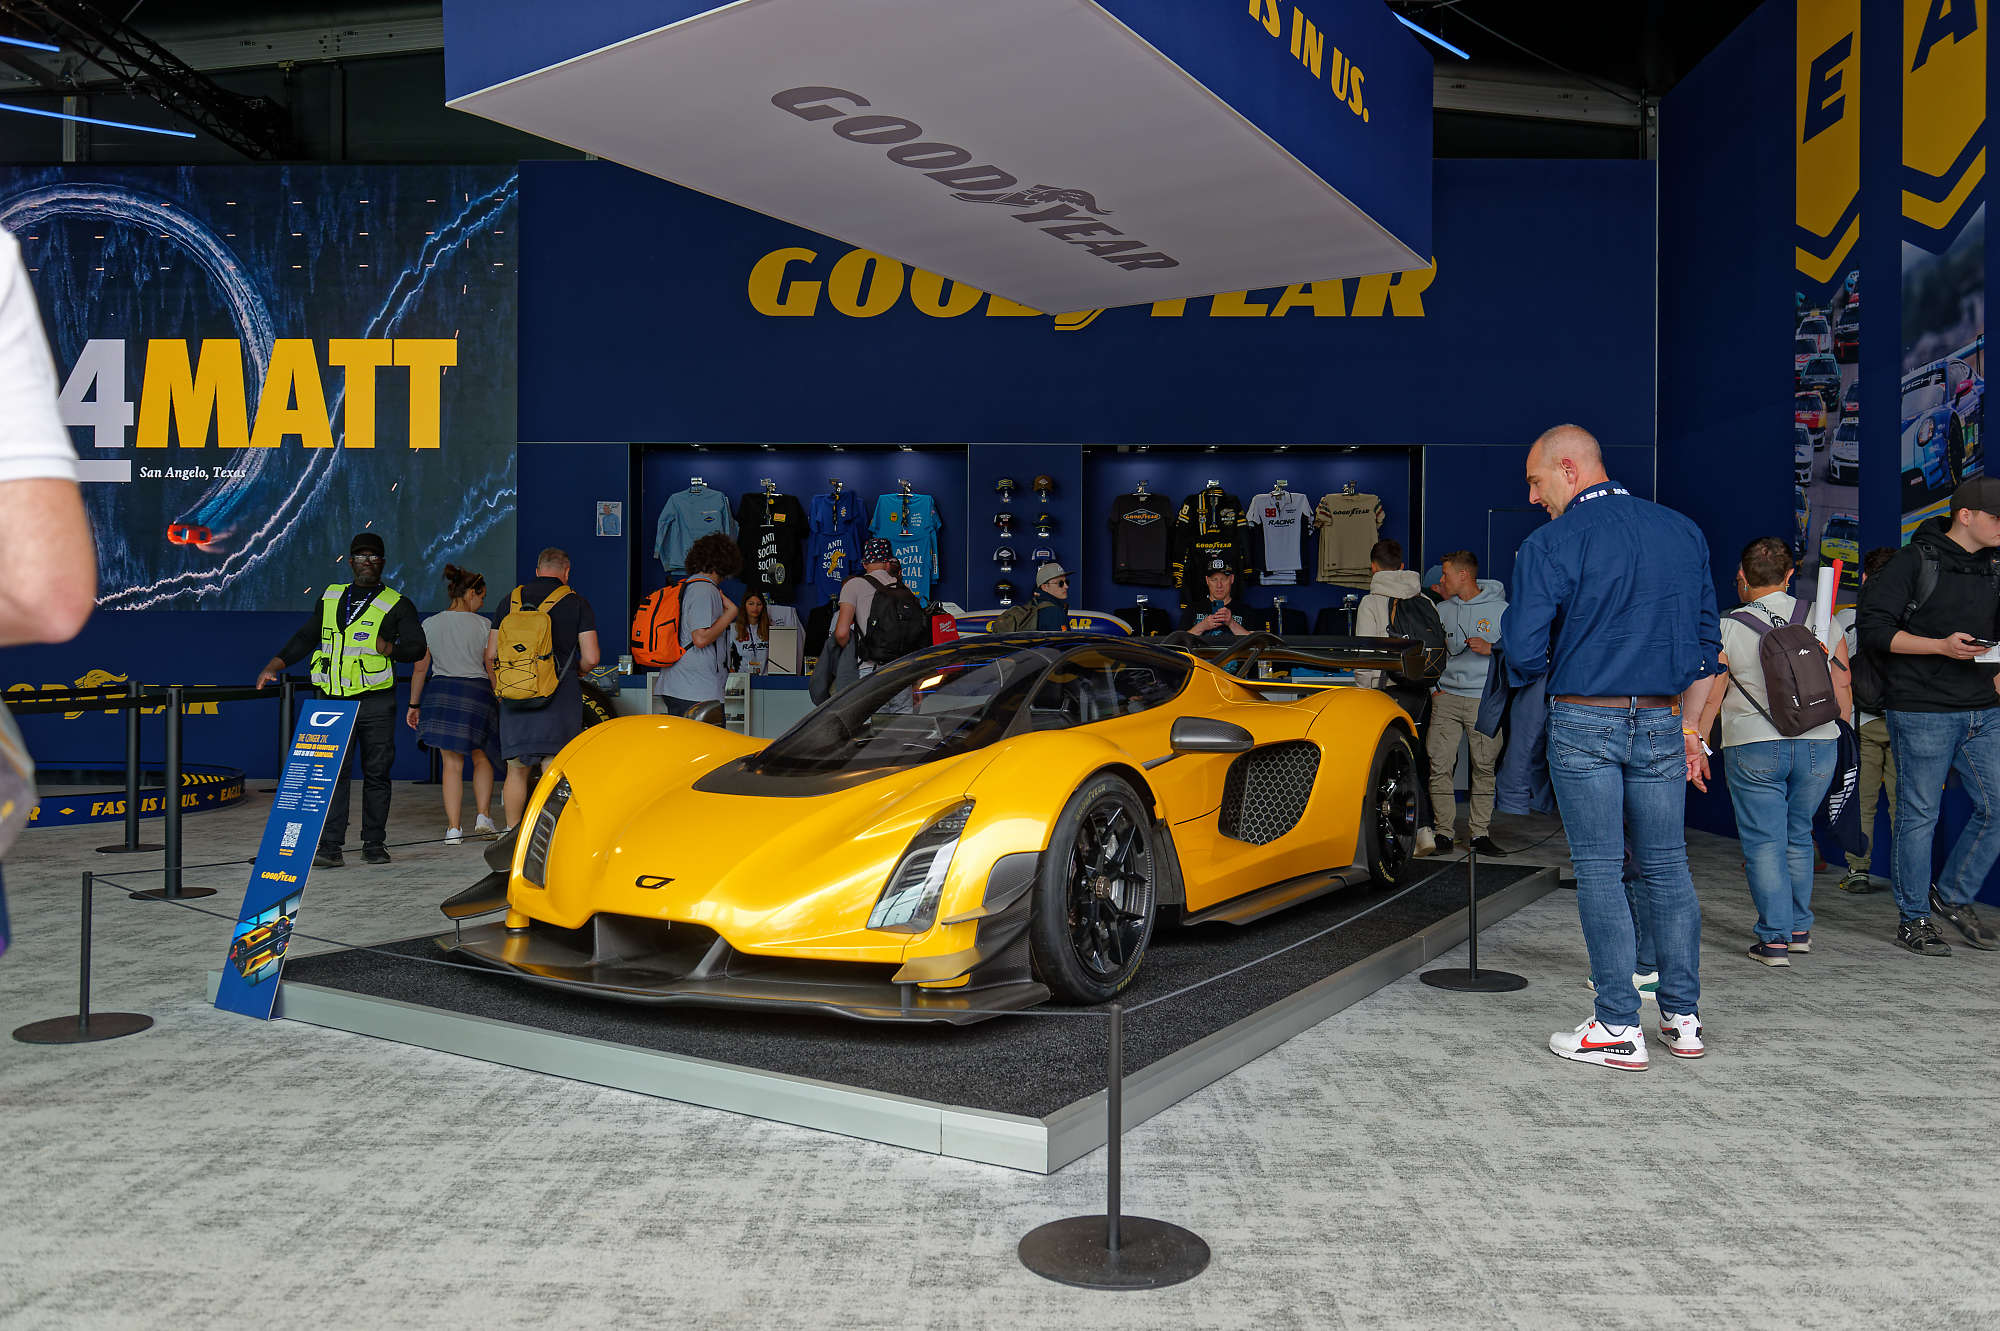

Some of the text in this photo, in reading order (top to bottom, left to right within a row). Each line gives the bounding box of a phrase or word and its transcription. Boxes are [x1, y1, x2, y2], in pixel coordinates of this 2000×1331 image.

[1290, 6, 1324, 80] IN
[1331, 46, 1369, 123] US.
[1802, 31, 1854, 145] E
[771, 86, 1180, 271] GOODYEAR
[748, 247, 1437, 318] GOOAR
[140, 466, 247, 481] San Angelo, Texas
[761, 532, 775, 546] ANTI
[827, 539, 842, 551] ANTI
[757, 544, 778, 559] SOCIAL
[895, 545, 919, 556] ANTI
[91, 800, 128, 817] FAS
[141, 797, 158, 812] IS
[181, 793, 200, 808] US.
[261, 870, 297, 883] GOODYEAR
